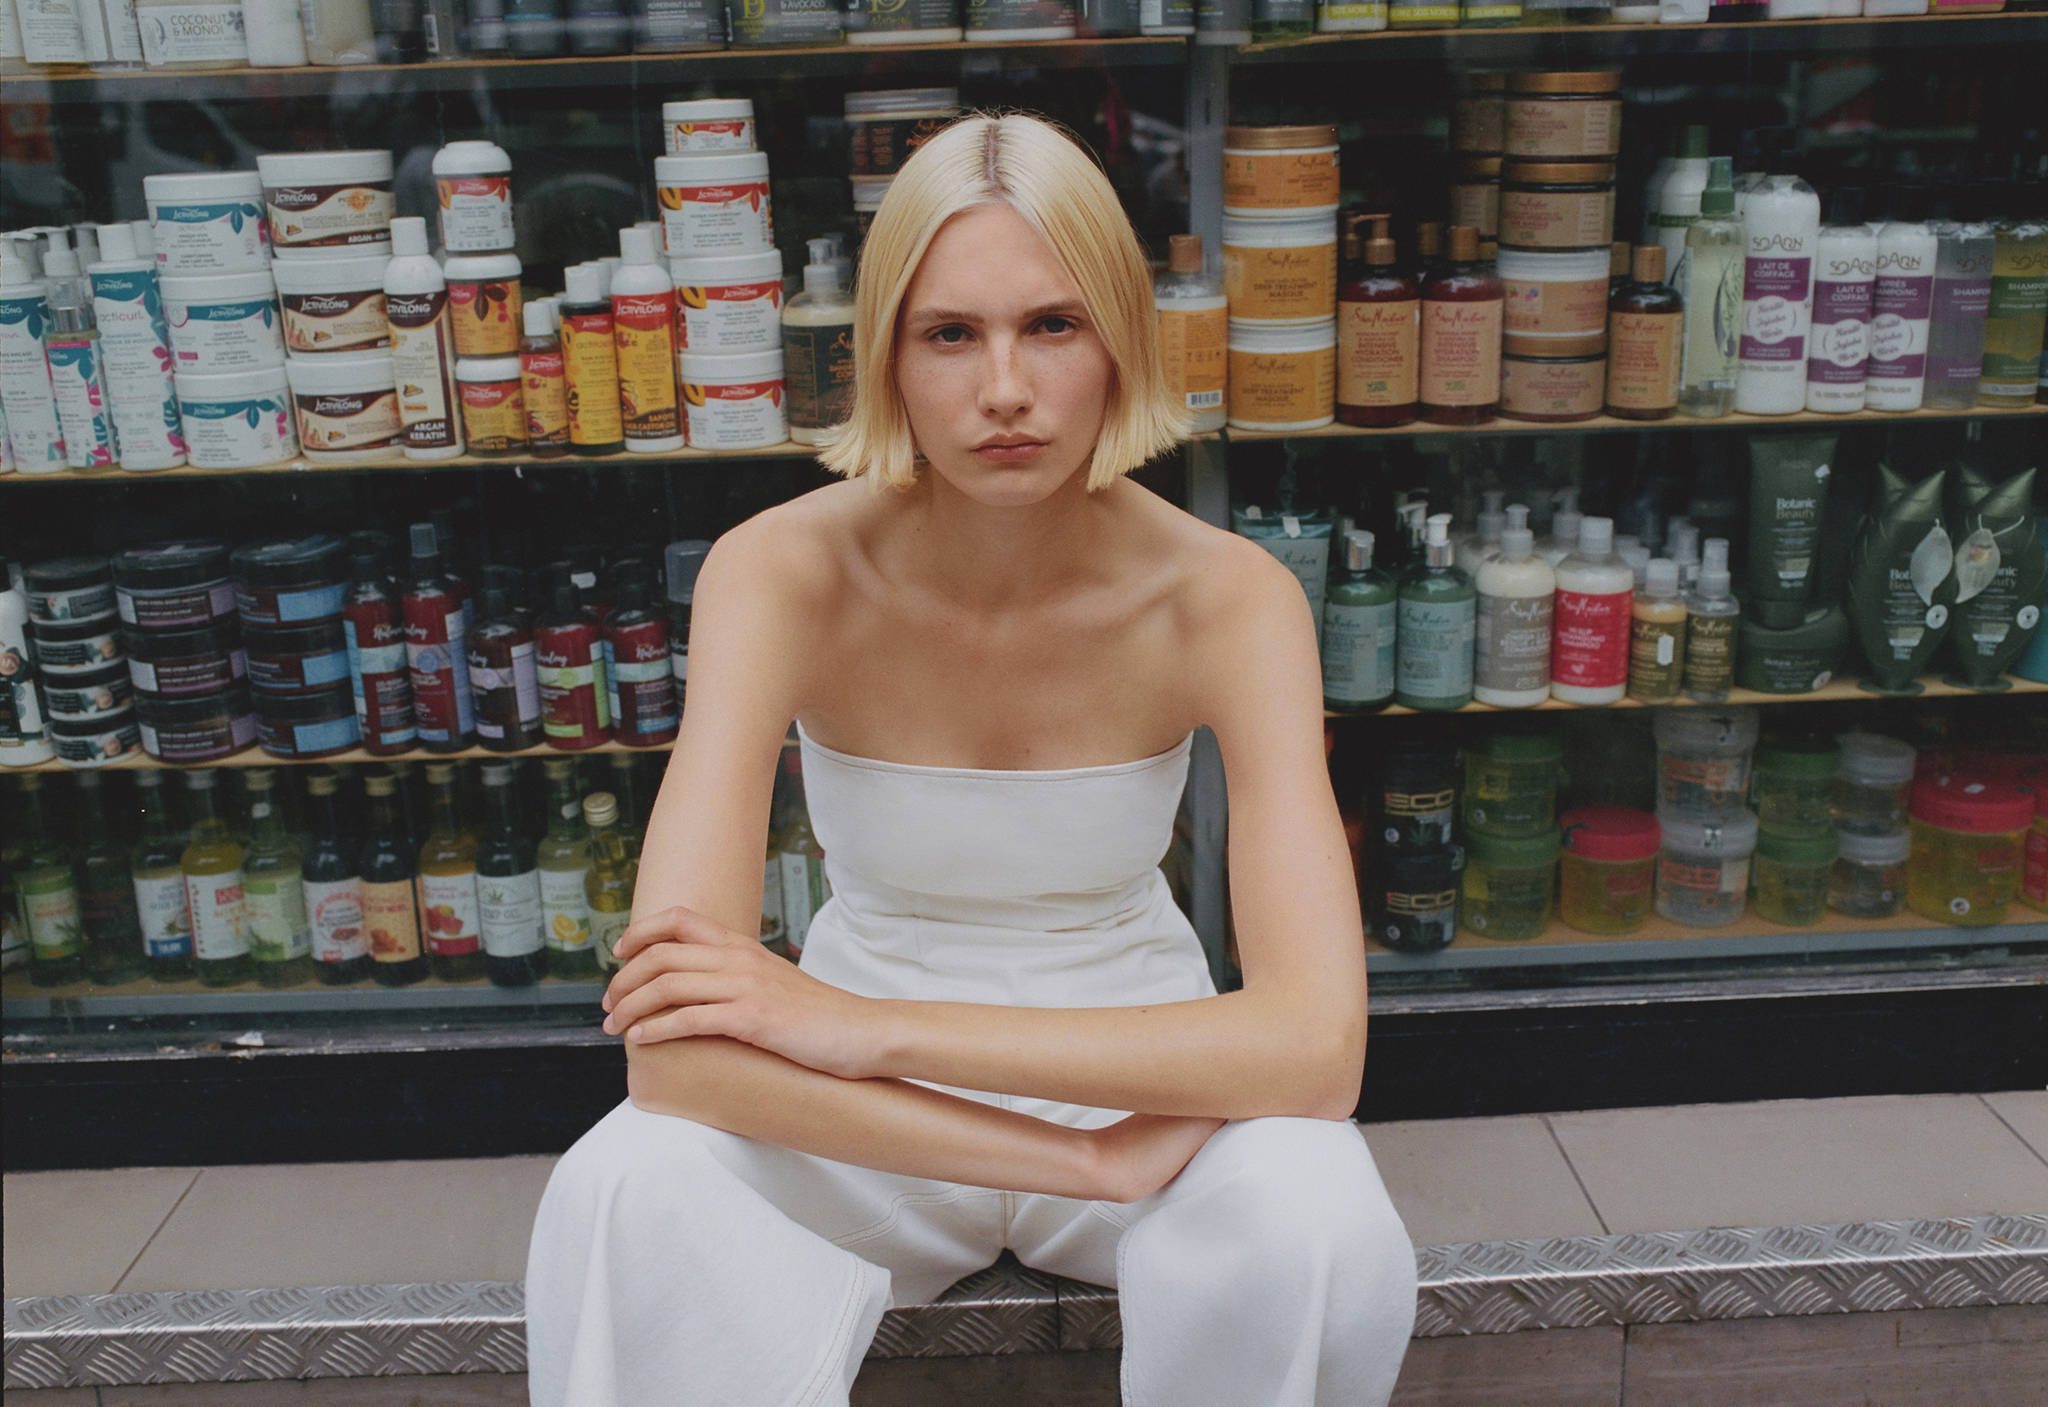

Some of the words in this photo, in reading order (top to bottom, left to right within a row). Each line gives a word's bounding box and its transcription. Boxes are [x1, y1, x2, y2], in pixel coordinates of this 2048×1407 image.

[170, 14, 226, 26] COCONUT
[615, 303, 667, 316] ACTIVILONG
[414, 422, 446, 432] ARGAN
[409, 431, 447, 442] KERATIN
[1776, 509, 1815, 522] Beauty
